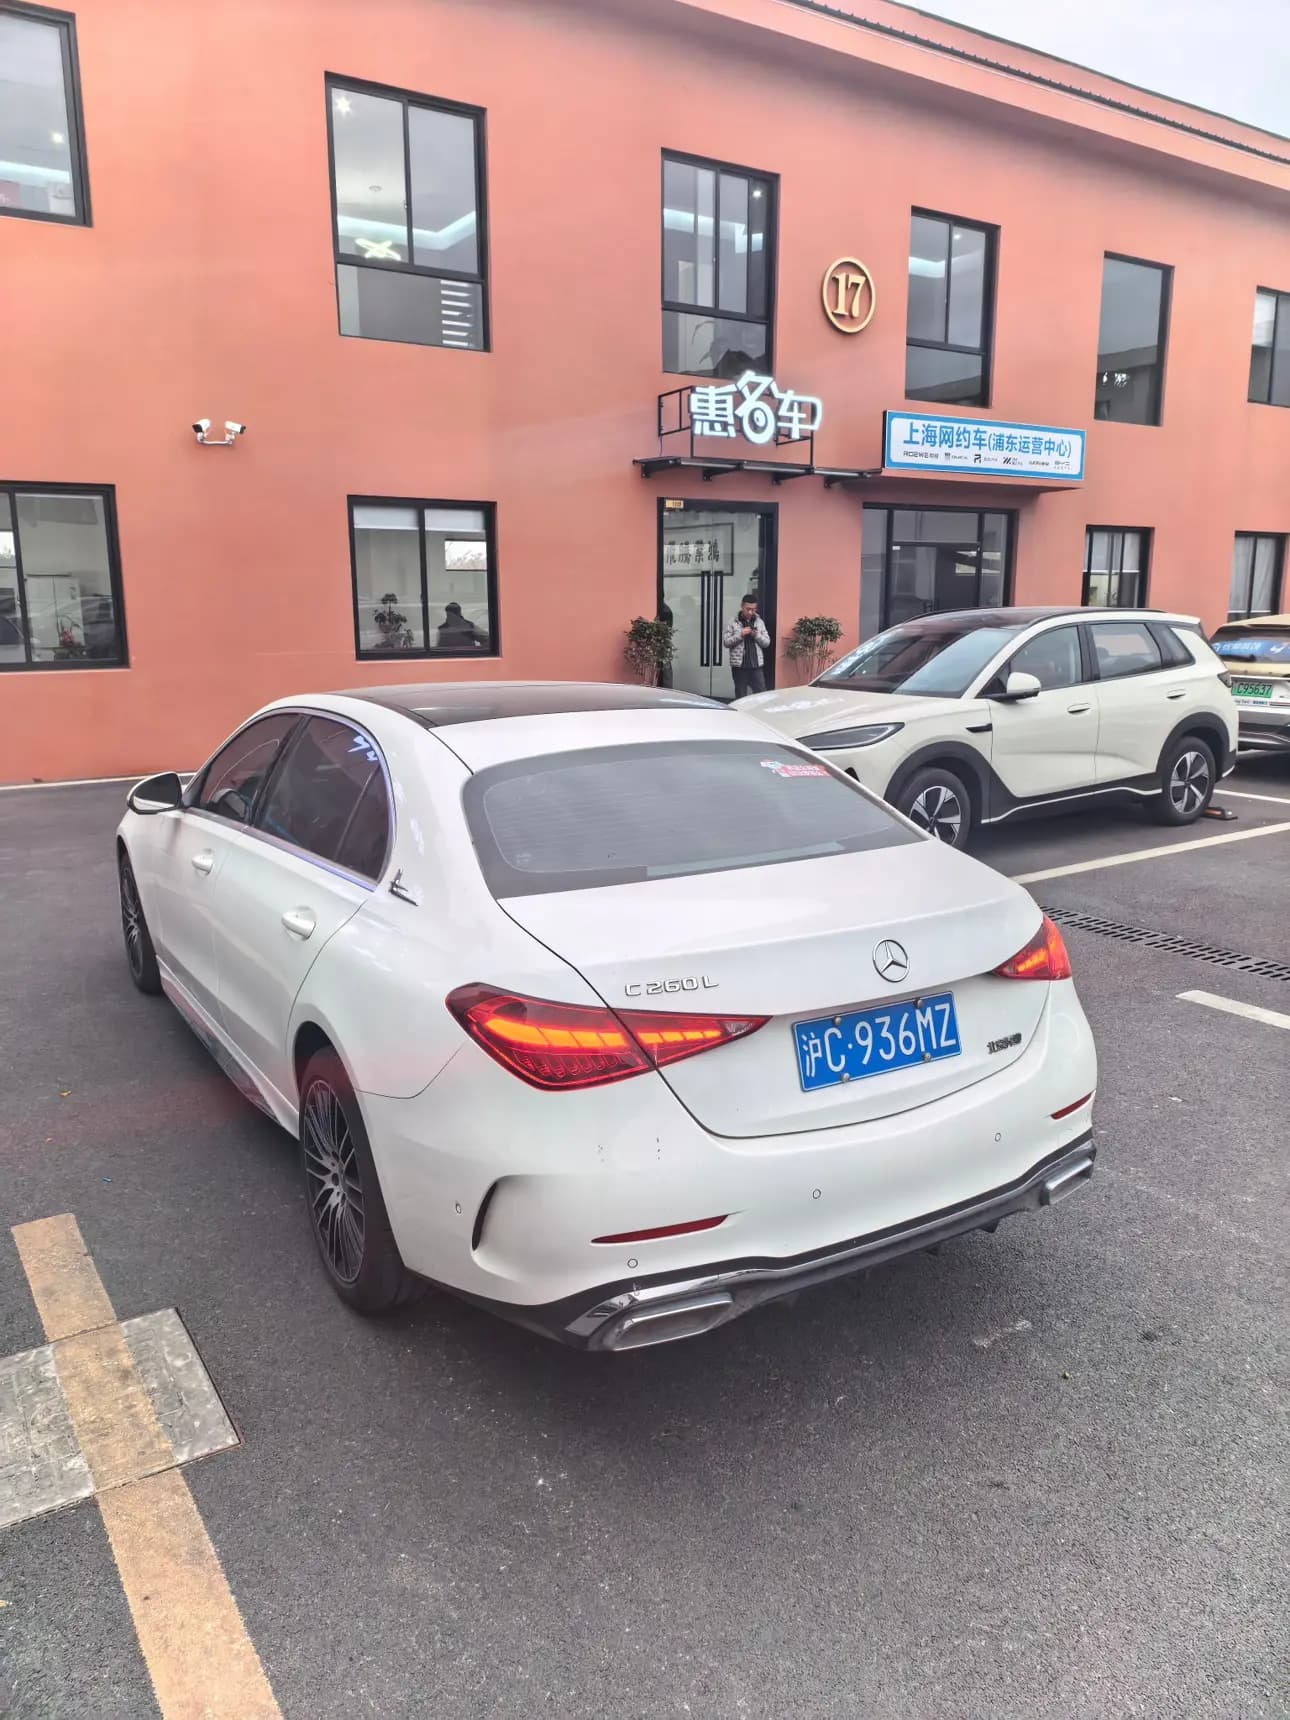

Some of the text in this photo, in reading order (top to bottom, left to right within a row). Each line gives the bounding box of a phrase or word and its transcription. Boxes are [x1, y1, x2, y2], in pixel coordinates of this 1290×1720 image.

[831, 272, 866, 318] 17
[903, 421, 1072, 459] 上海网约车(浦东运营中心)
[624, 975, 719, 997] C 260 L
[801, 1003, 957, 1078] 沪C·936MZ
